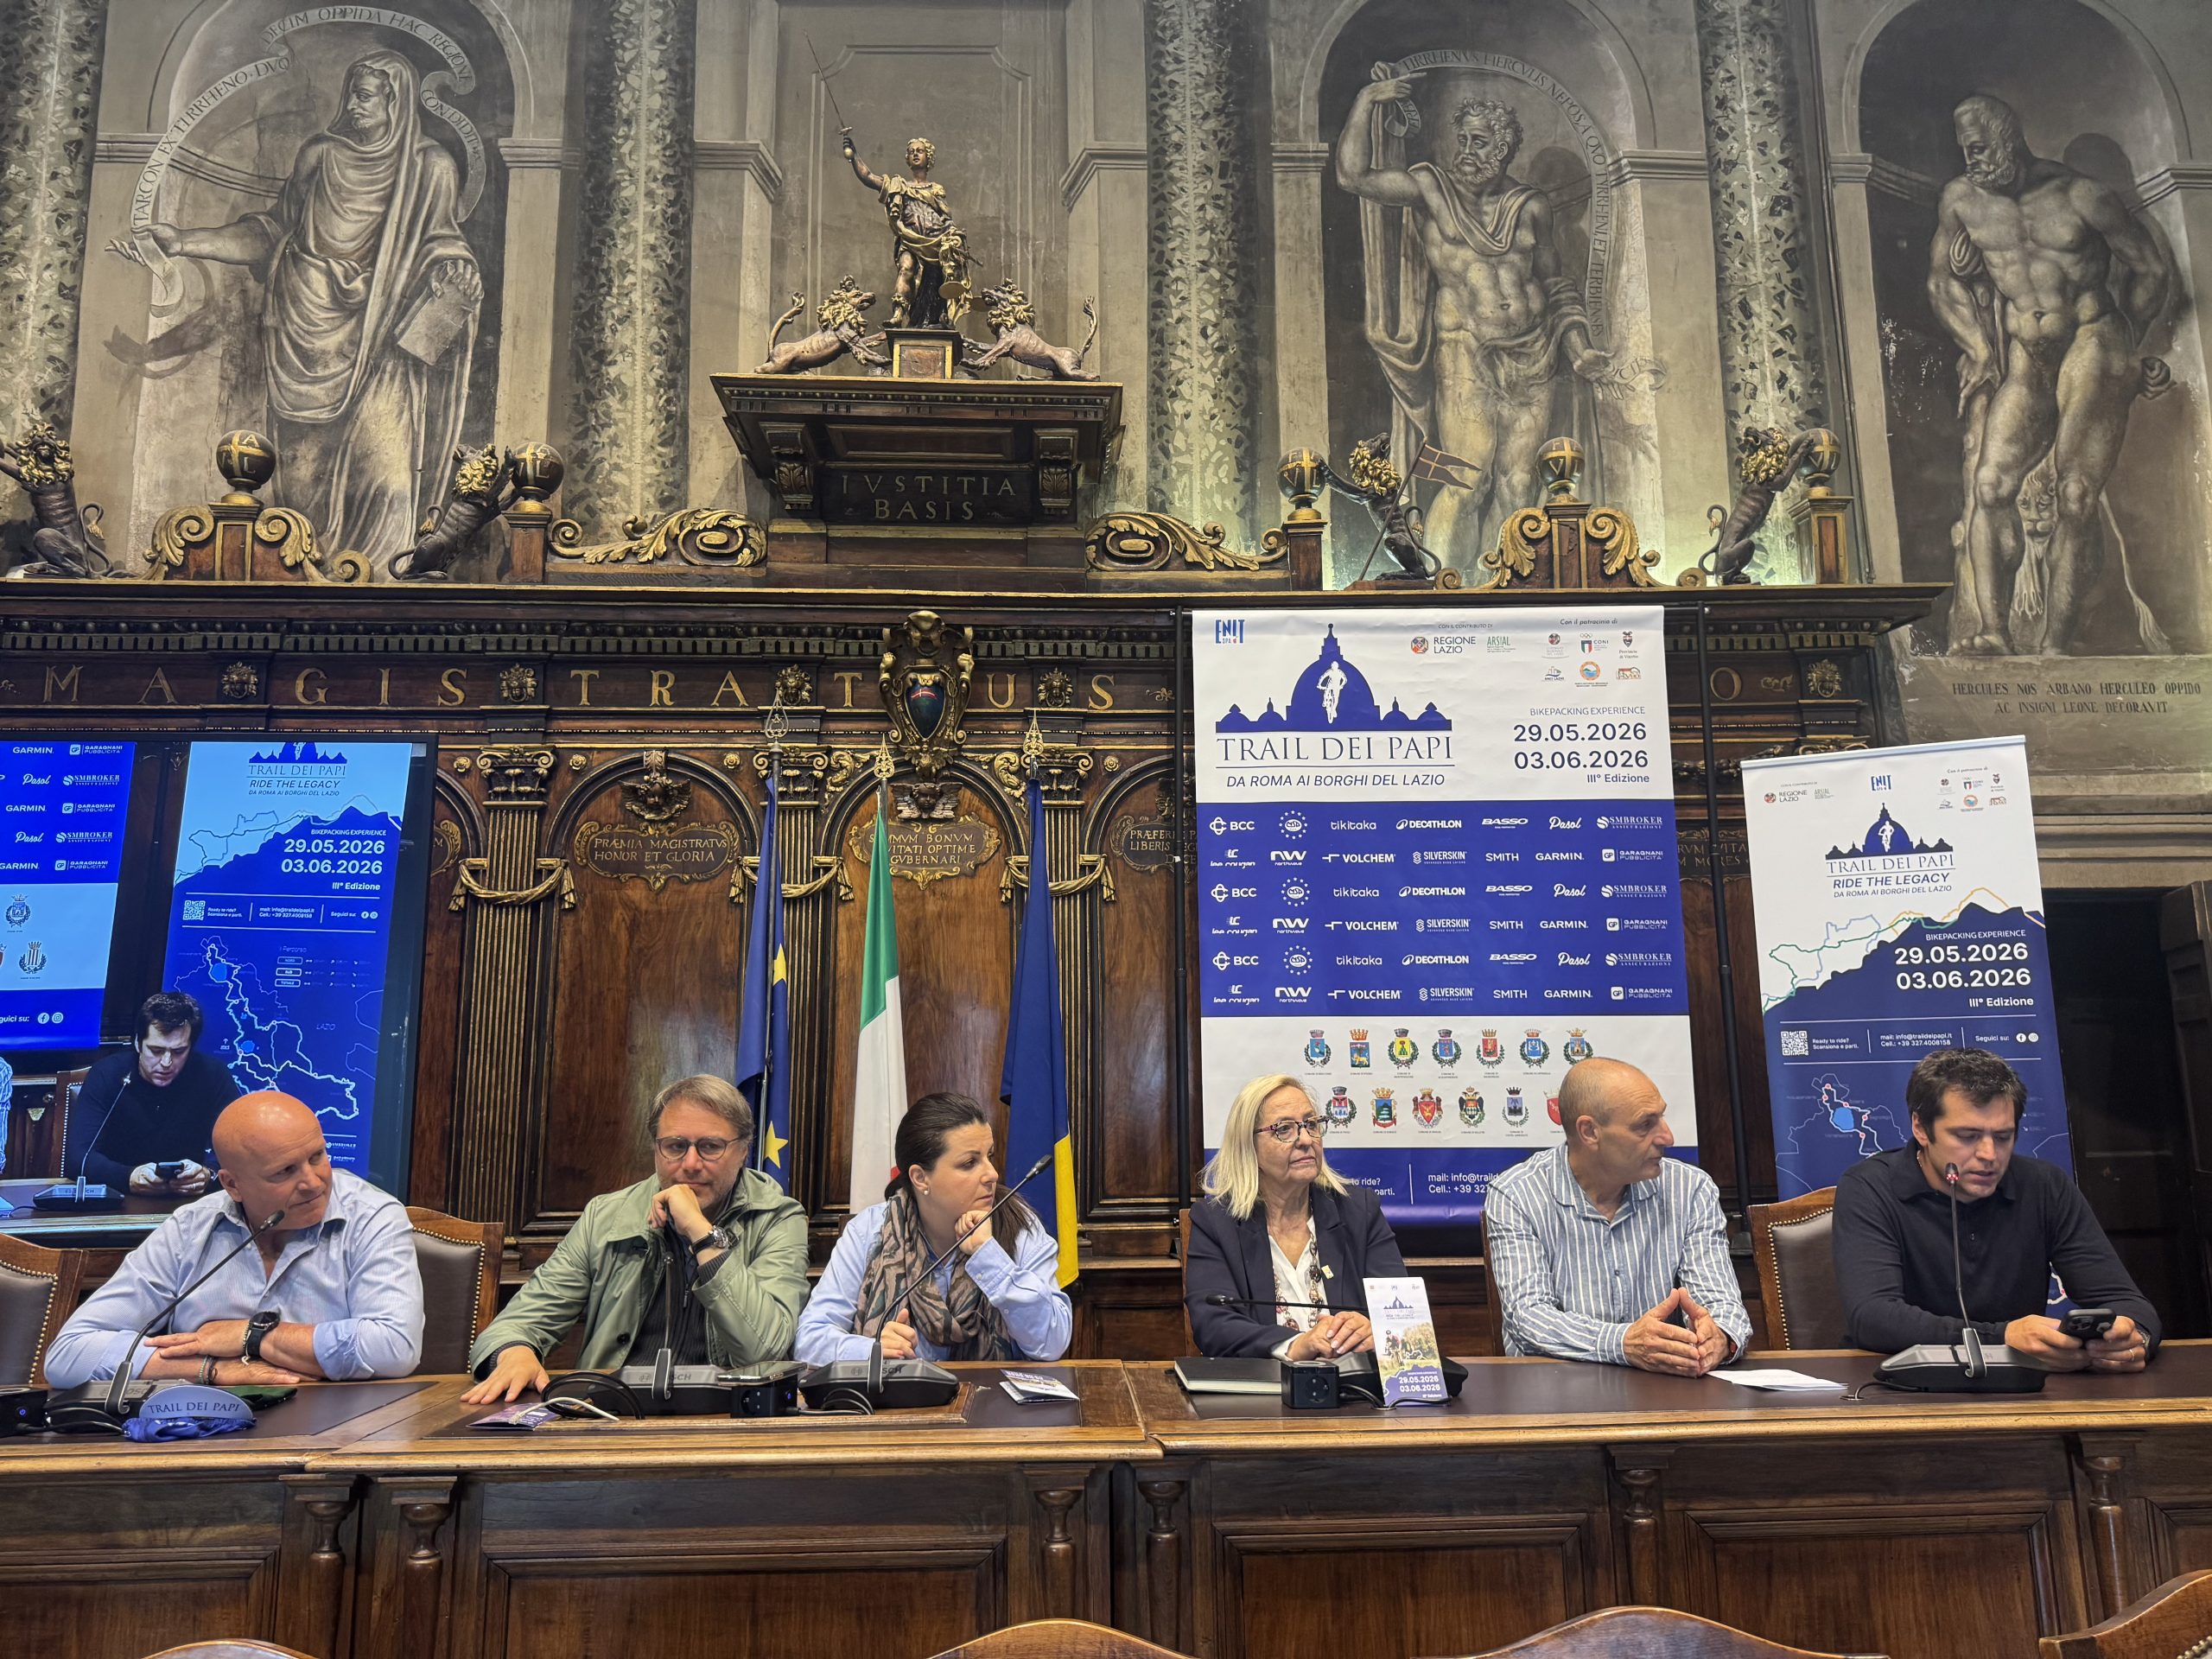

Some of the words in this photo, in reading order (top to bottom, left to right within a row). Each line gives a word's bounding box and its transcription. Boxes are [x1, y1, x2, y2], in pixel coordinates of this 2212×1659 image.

[133, 158, 164, 226] TARCON
[157, 136, 177, 156] EX
[170, 71, 248, 132] TIRRHENO
[254, 57, 289, 76] DVO
[318, 7, 382, 22] OPPIDA
[389, 14, 429, 35] HAC
[1586, 136, 1606, 165] QVO
[842, 475, 1016, 496] IVSTITIA
[874, 499, 976, 520] BASIS
[1216, 620, 1244, 644] ENIT
[1433, 636, 1476, 645] REGIONE
[1487, 636, 1510, 646] ARSIAL
[1433, 645, 1463, 654] LAZIO
[1952, 683, 2009, 695] HERCULES
[2017, 683, 2037, 695] NOS
[2100, 682, 2156, 695] HERCULEO
[2164, 682, 2201, 694] OPPIDO
[1994, 702, 2009, 714] AC
[2063, 701, 2097, 713] LEONE
[2106, 701, 2169, 713] DECORAVIT
[1513, 722, 1646, 741] 29.05.2026
[1217, 736, 1309, 760] TRAIL
[1321, 736, 1374, 760] DEI
[1389, 736, 1452, 760] PAPI
[1514, 750, 1649, 769] 03.06.2026
[248, 766, 286, 775] TRAIL
[291, 766, 313, 776] DEI
[319, 766, 346, 776] PAPI
[22, 773, 51, 785] Pasol
[1227, 776, 1246, 787] DA
[1250, 775, 1293, 786] ROMA
[1297, 775, 1310, 786] AI
[1314, 775, 1368, 786] BORGHI
[1372, 774, 1399, 786] DEL
[1402, 774, 1445, 785] LAZIO
[1586, 774, 1601, 783] III°
[1605, 773, 1649, 783] Edizione
[1871, 775, 1891, 791] ENIT
[1230, 821, 1255, 830] BCC
[1331, 820, 1376, 830] tikitaka
[1409, 820, 1462, 829] DECATHLON
[1549, 817, 1582, 830] Pasol
[15, 831, 44, 843] Pasol
[926, 835, 973, 843] BONVM
[283, 839, 385, 854] 29.05.2026
[650, 839, 728, 849] MAGISTRATVS
[1130, 842, 1170, 851] LIBERIS
[928, 845, 976, 854] OPTIME
[594, 851, 637, 861] HONOR
[645, 851, 661, 862] ET
[666, 851, 715, 862] GLORIA
[891, 855, 961, 864] GVBERNARI
[1342, 854, 1395, 863] VOLCHEM
[1423, 851, 1465, 861] SILVERSKIN
[1485, 853, 1519, 861] SMITH
[281, 859, 383, 874] 03.06.2026
[1827, 859, 1876, 874] TRAIL
[1883, 857, 1910, 870] DEI
[1918, 854, 1955, 868] PAPI
[1833, 878, 1862, 889] RIDE
[1866, 876, 1892, 887] THE
[1896, 873, 1950, 885] LEGACY
[345, 882, 380, 891] Edizione
[1412, 887, 1465, 896] DECATHLON
[1554, 883, 1586, 898] Pasol
[1232, 888, 1257, 898] BCC
[1333, 887, 1380, 897] tikitaka
[1345, 921, 1398, 931] VOLCHEM
[1427, 919, 1469, 928] SILVERSKIN
[1489, 921, 1523, 930] SMITH
[1540, 920, 1588, 929] GARMIN
[1925, 932, 1977, 941] BIKEPACKING
[1978, 930, 2026, 938] EXPERIENCE
[1558, 952, 1591, 966] Pasol
[1894, 943, 2029, 965] 29.05.2026
[1233, 956, 1259, 965] BCC
[1336, 955, 1382, 965] tikitaka
[1414, 956, 1469, 964] DECATHLON
[1896, 968, 2031, 989] 03.06.2026
[1348, 989, 1401, 1000] VOLCHEM
[1430, 988, 1473, 997] SILVERSKIN
[1493, 989, 1528, 999] SMITH
[1543, 989, 1592, 998] GARMIN
[1986, 997, 2034, 1007] Edizione
[1428, 1173, 1449, 1182] mail:
[1429, 1185, 1452, 1193] Cell.:
[1453, 1185, 1471, 1193] +39
[148, 1403, 182, 1414] TRAIL
[187, 1402, 208, 1411] DEI
[213, 1402, 240, 1413] PAPI
